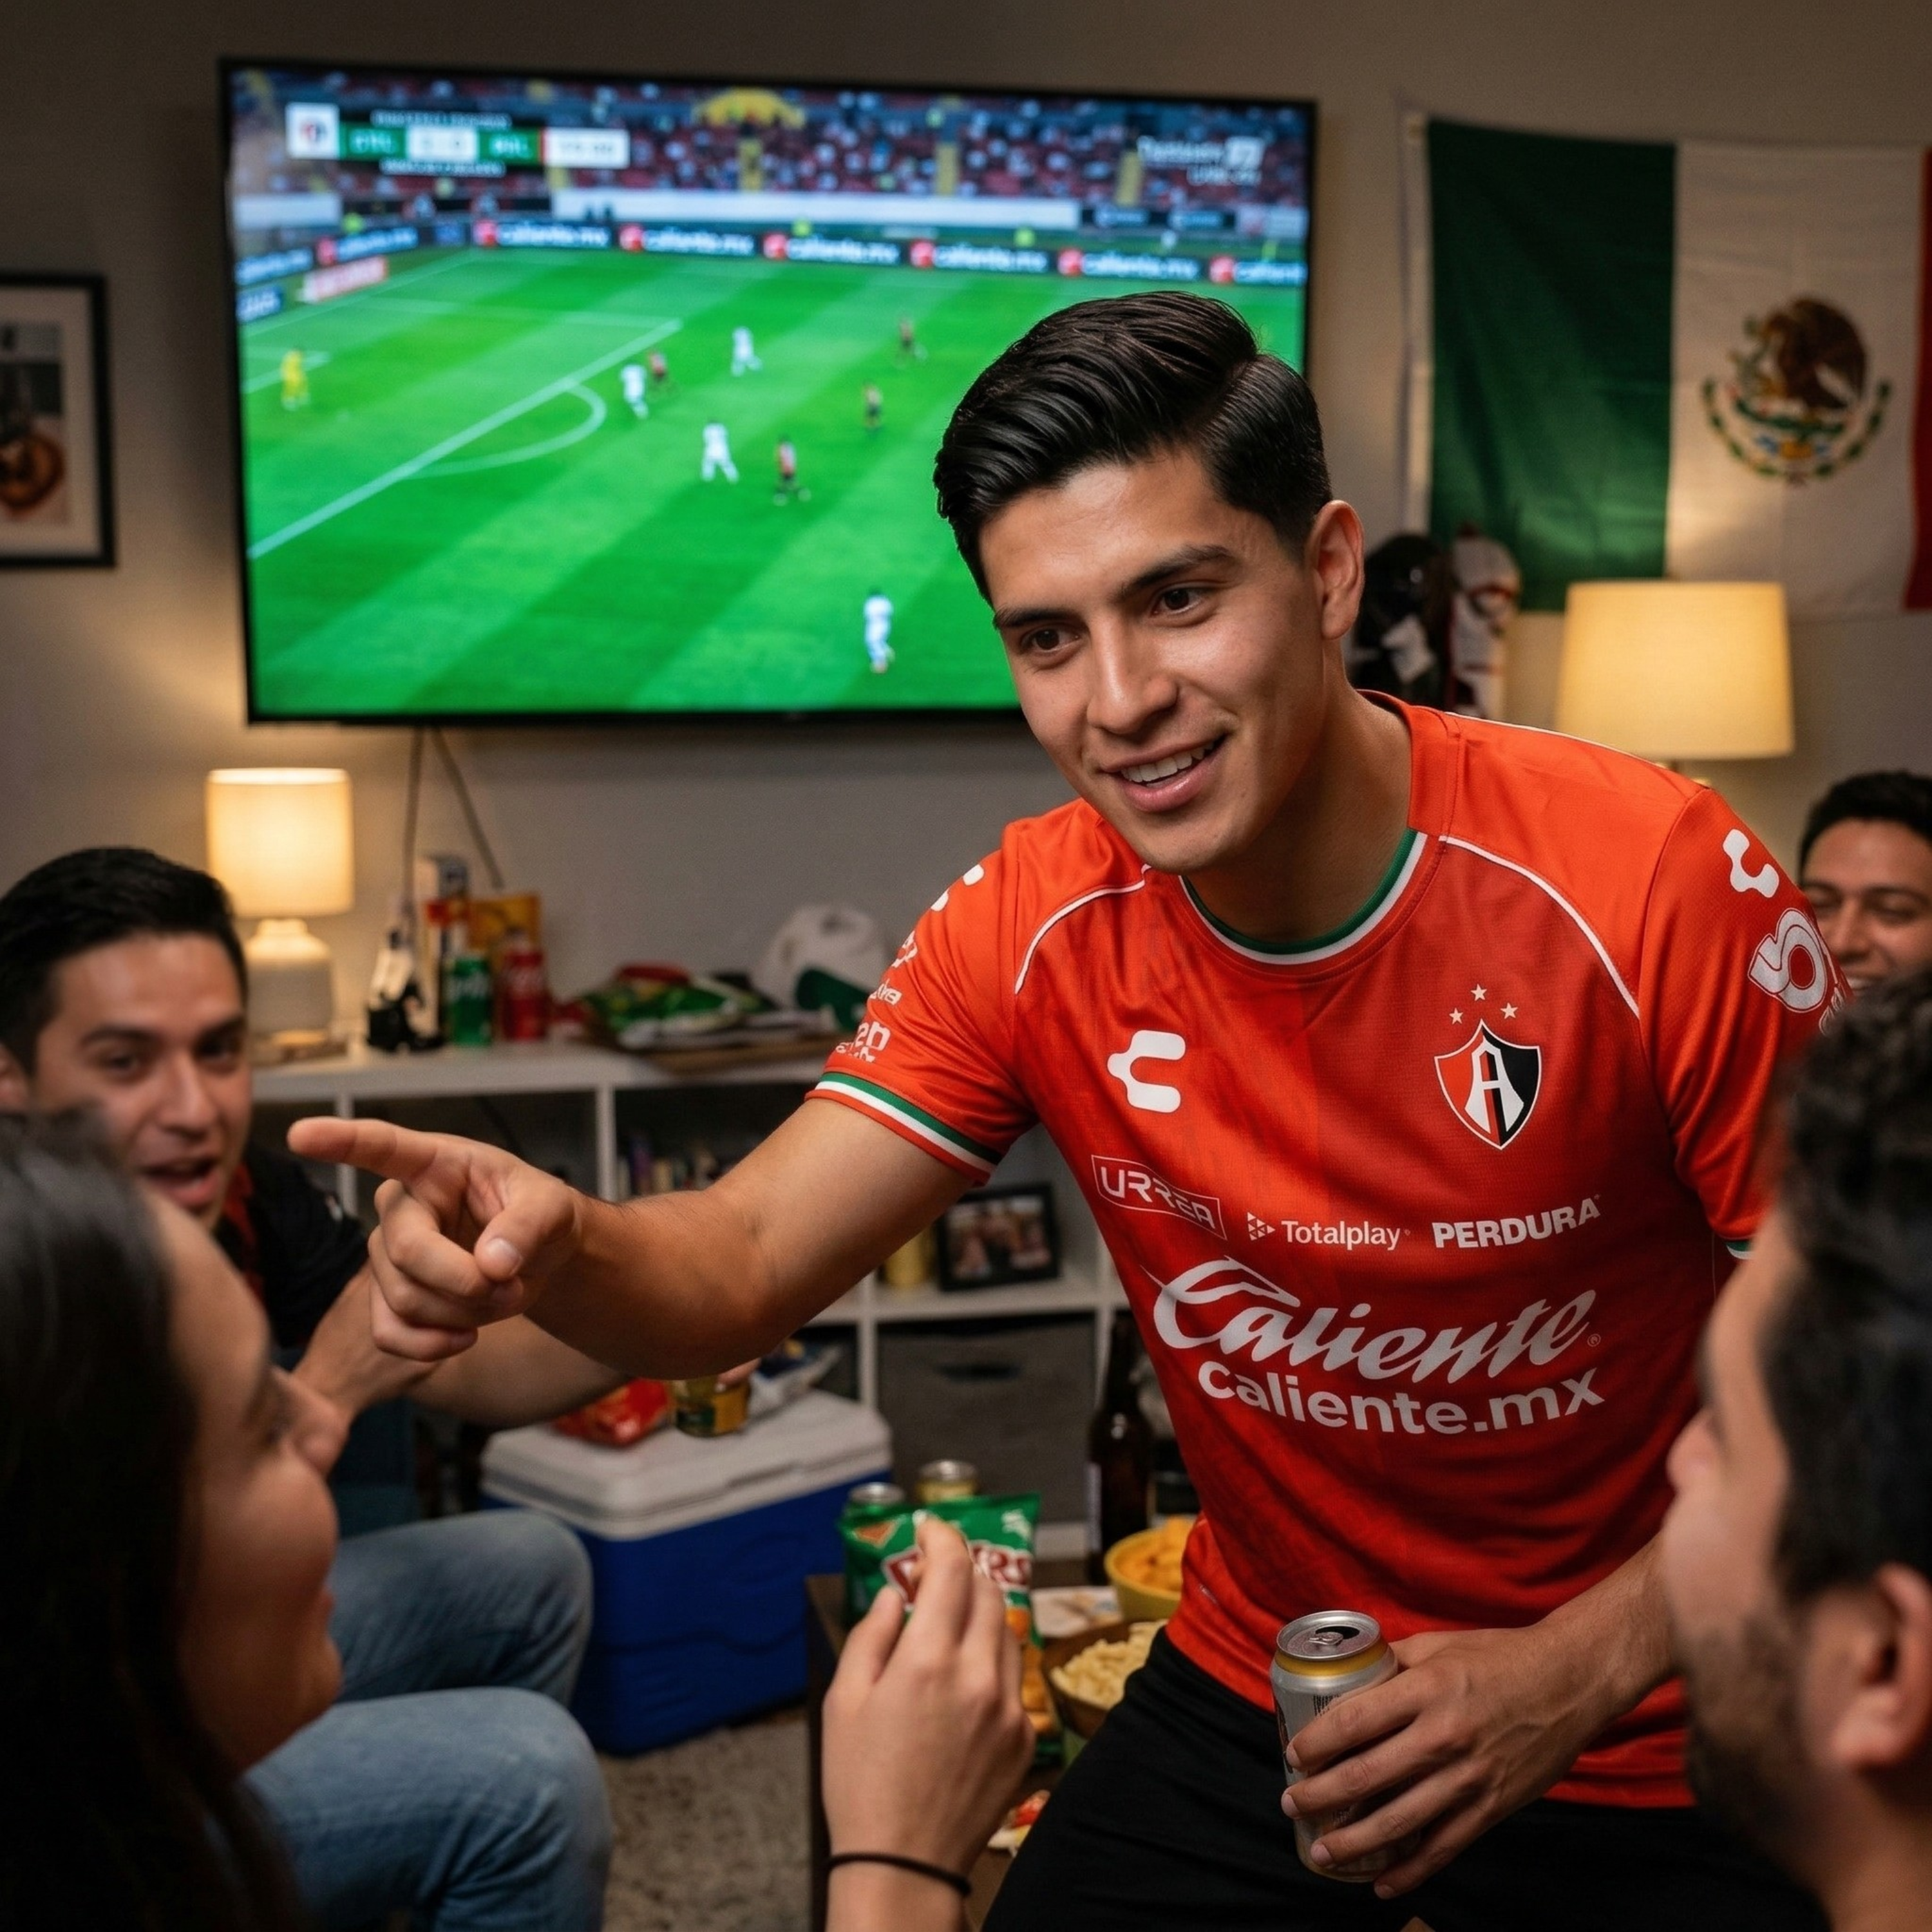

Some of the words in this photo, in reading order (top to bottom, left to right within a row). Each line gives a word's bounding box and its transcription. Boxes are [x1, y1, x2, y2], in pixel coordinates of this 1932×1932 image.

[1101, 1166, 1215, 1229] URREA
[1432, 1197, 1601, 1248] PERDURA
[1281, 1220, 1401, 1251] Totalplay
[1141, 1255, 1597, 1383] Caliente
[1198, 1360, 1605, 1434] caliente.mx
